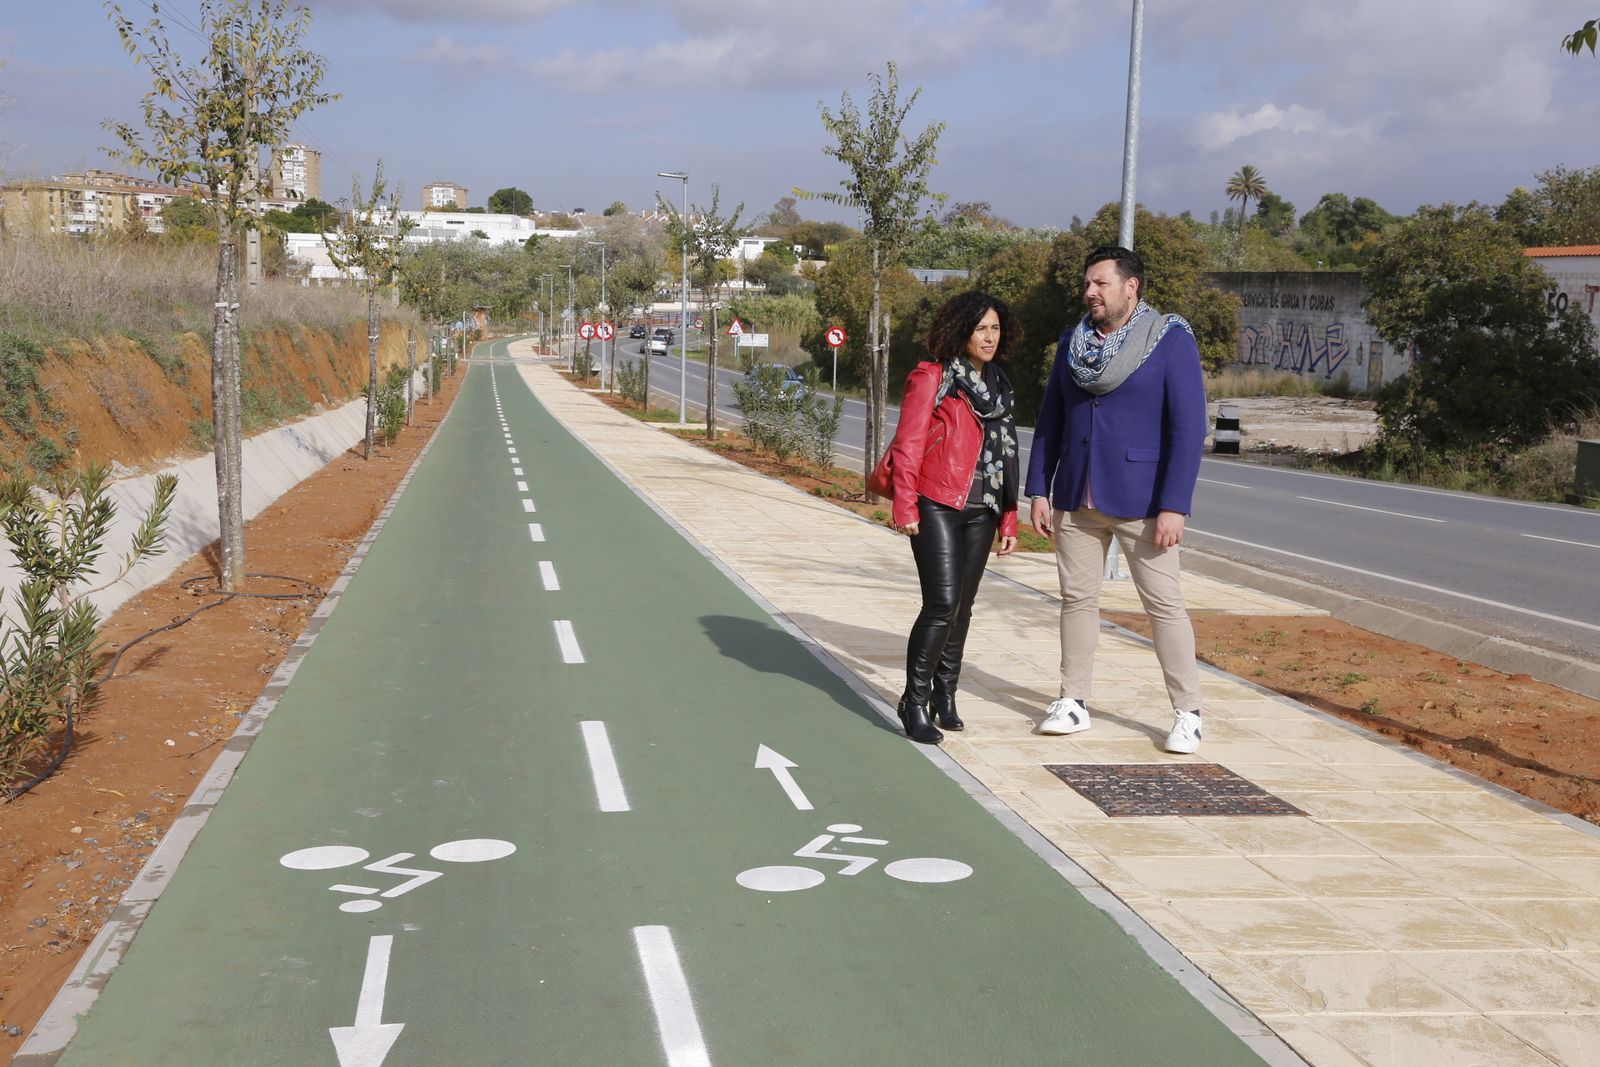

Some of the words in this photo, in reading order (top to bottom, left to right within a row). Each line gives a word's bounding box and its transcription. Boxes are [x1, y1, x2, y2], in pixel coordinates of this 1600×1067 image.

[1270, 293, 1279, 308] DE
[1281, 294, 1299, 309] GRUA
[1302, 294, 1307, 310] Y
[1309, 294, 1335, 311] CUBAS
